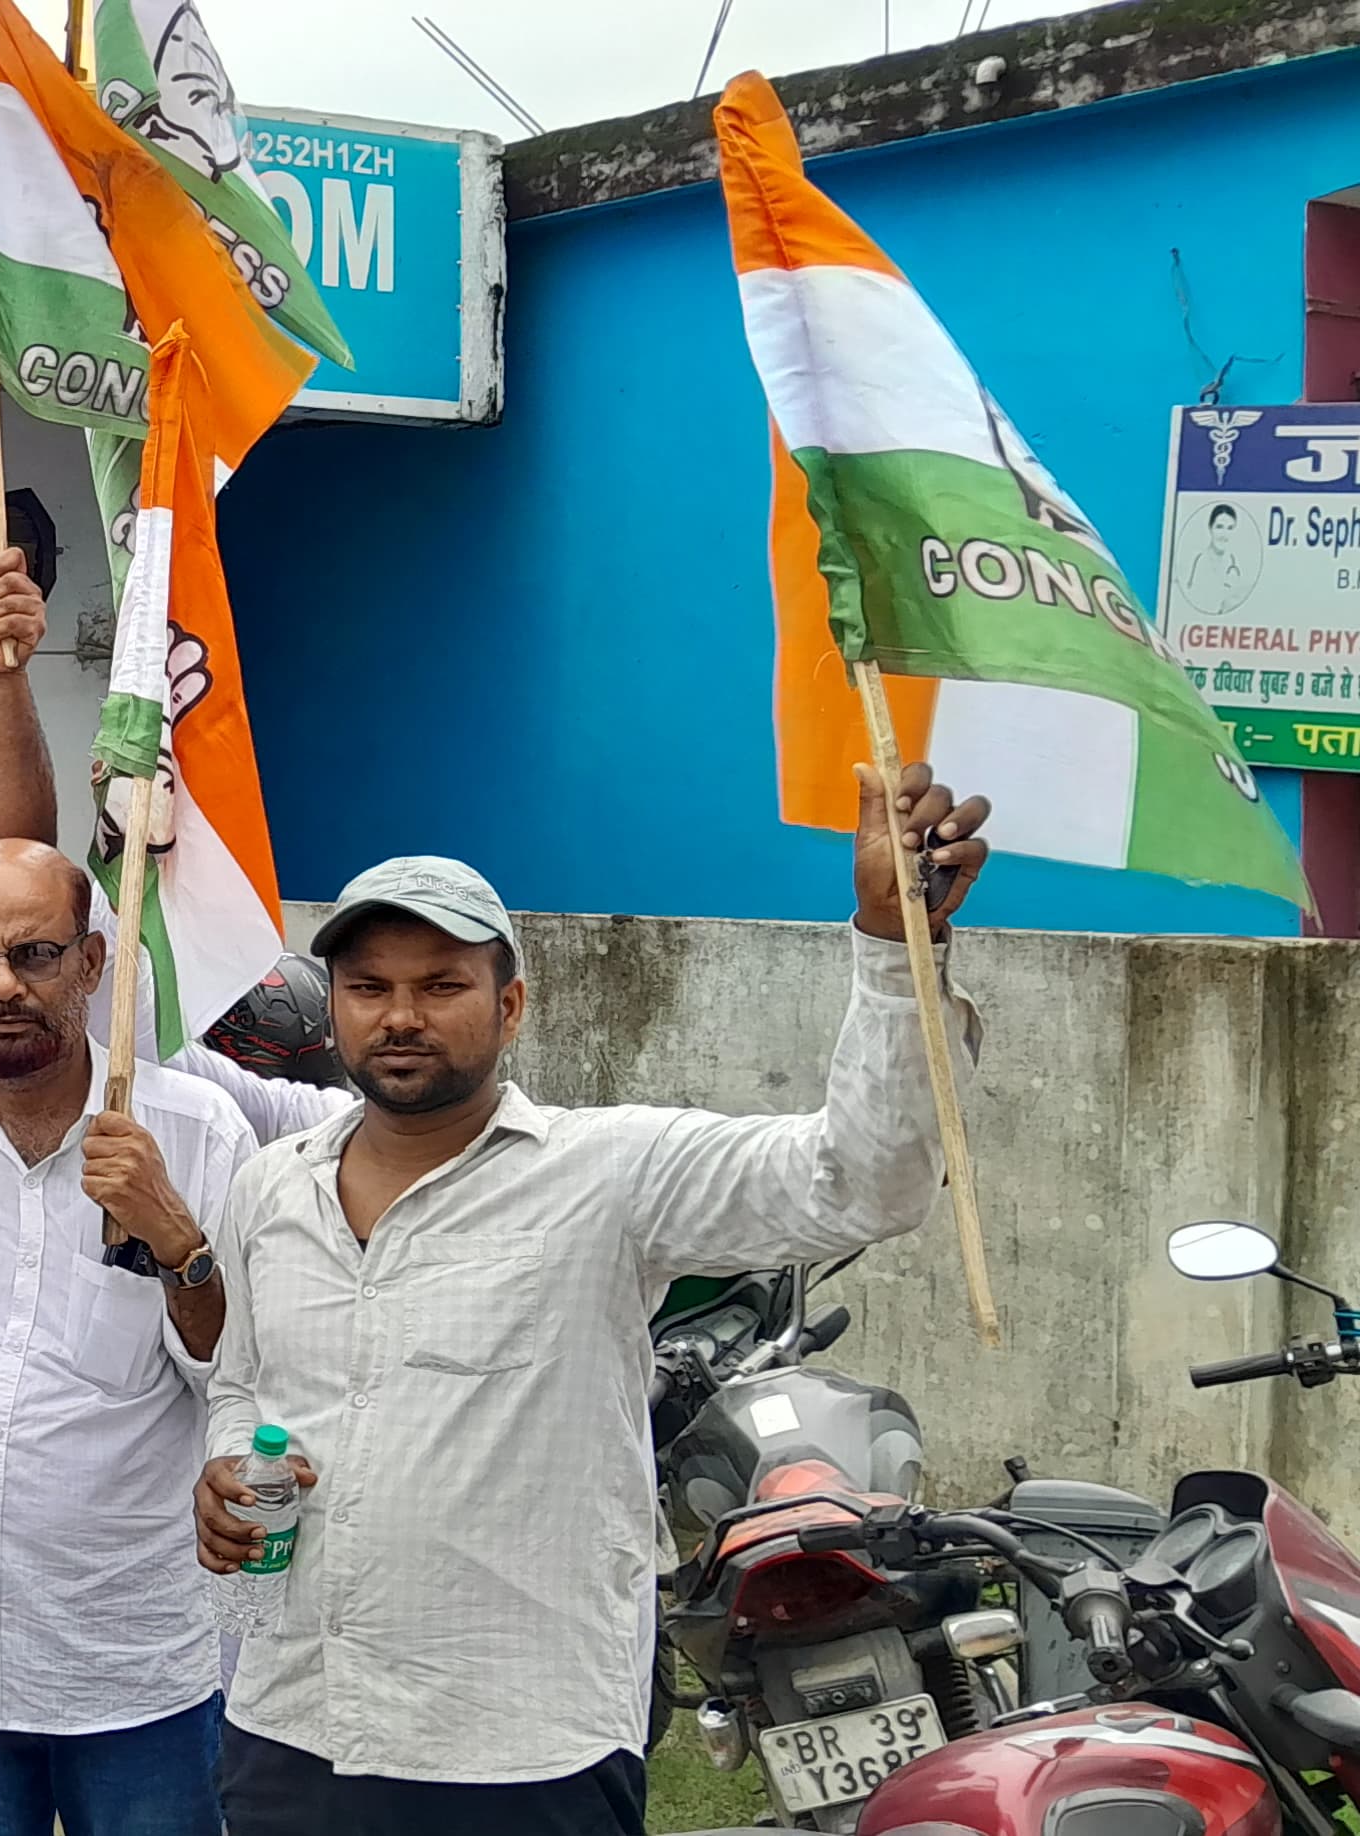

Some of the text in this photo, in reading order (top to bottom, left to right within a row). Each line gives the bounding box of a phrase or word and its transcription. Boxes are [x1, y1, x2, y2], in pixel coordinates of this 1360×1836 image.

[18, 343, 150, 424] CON
[1268, 506, 1297, 546] Dr.
[1180, 624, 1360, 654] (GENERAL PHY
[1295, 672, 1305, 696] 9
[793, 1708, 922, 1765] BR 39
